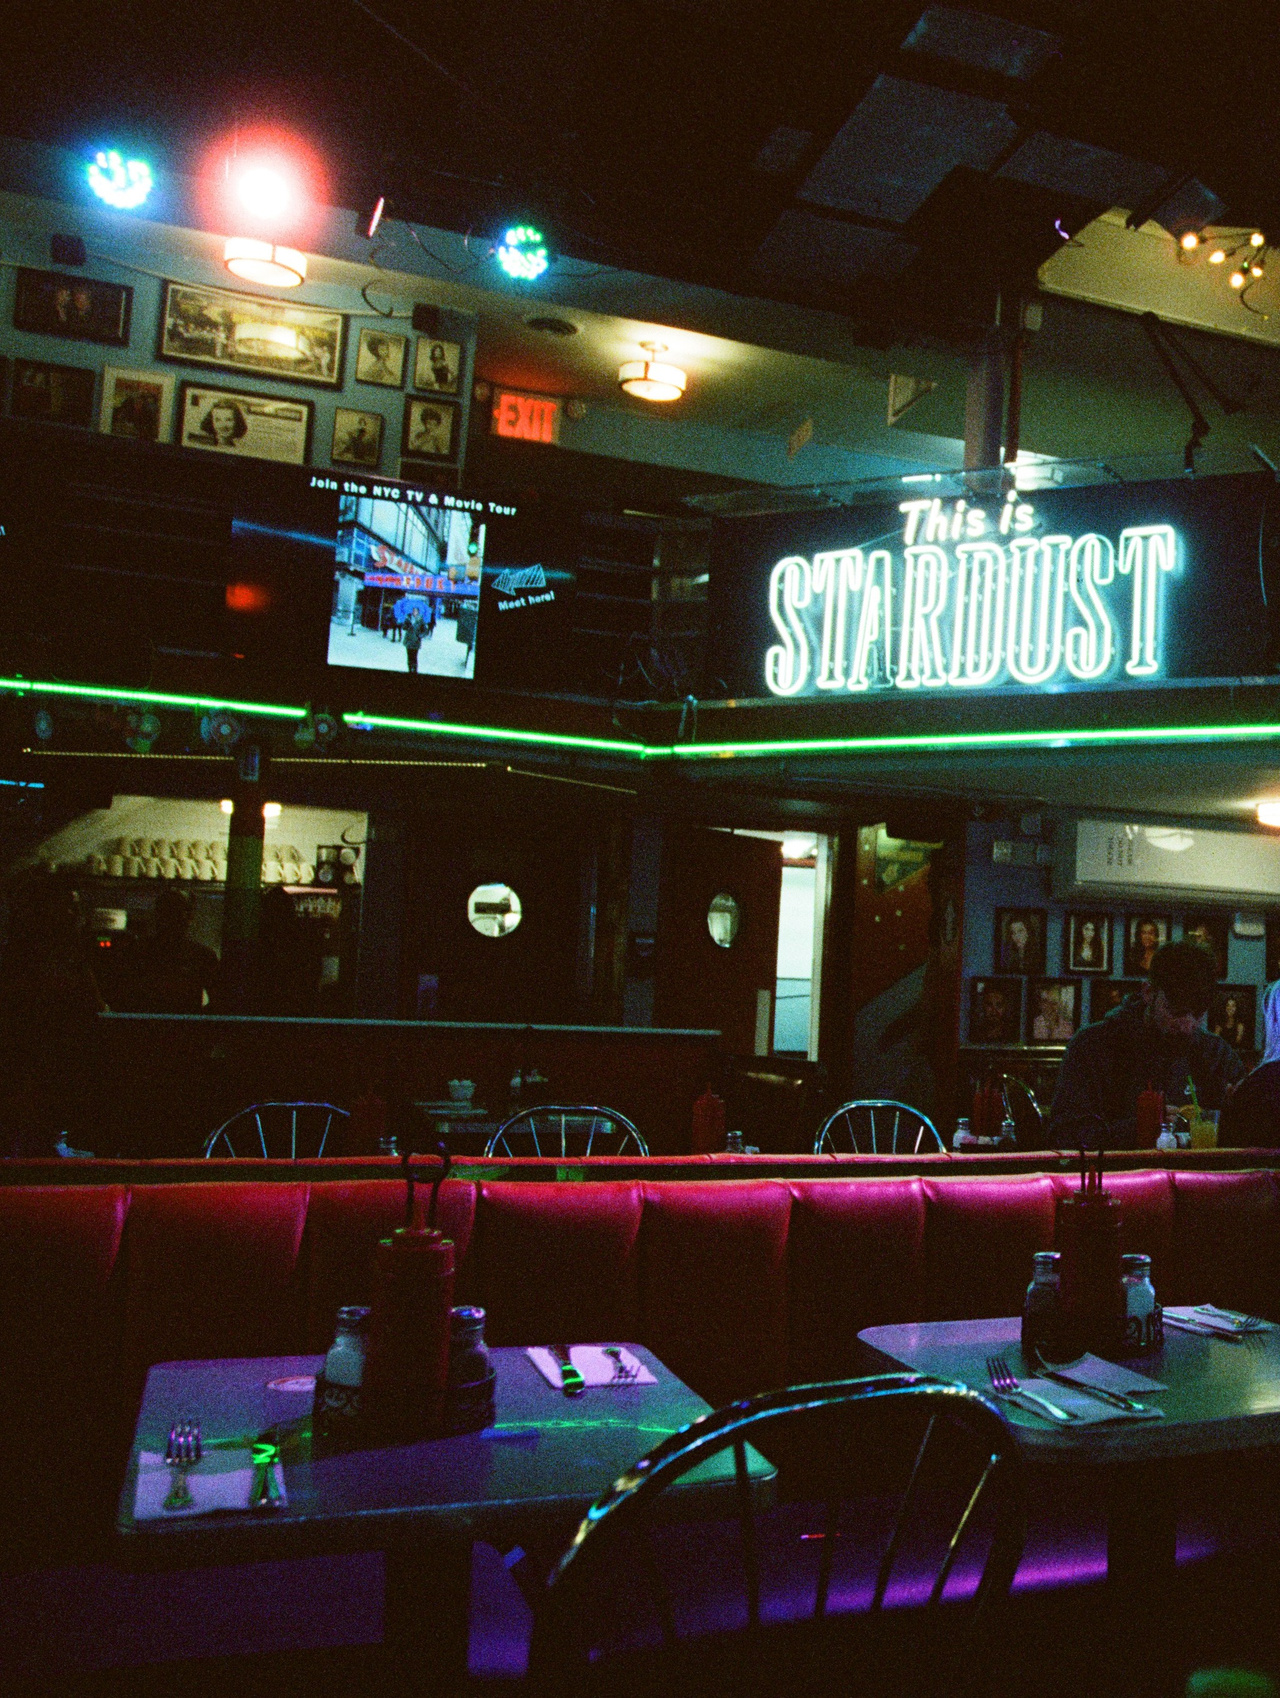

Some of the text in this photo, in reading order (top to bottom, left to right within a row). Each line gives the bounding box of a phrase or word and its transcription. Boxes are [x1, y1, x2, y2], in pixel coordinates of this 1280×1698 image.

[498, 394, 557, 443] EXIT
[309, 476, 517, 516] Join the NYC TV & Movie Tour
[900, 489, 1035, 546] This is
[498, 590, 555, 611] Meet here!
[765, 524, 1177, 698] STARDUST
